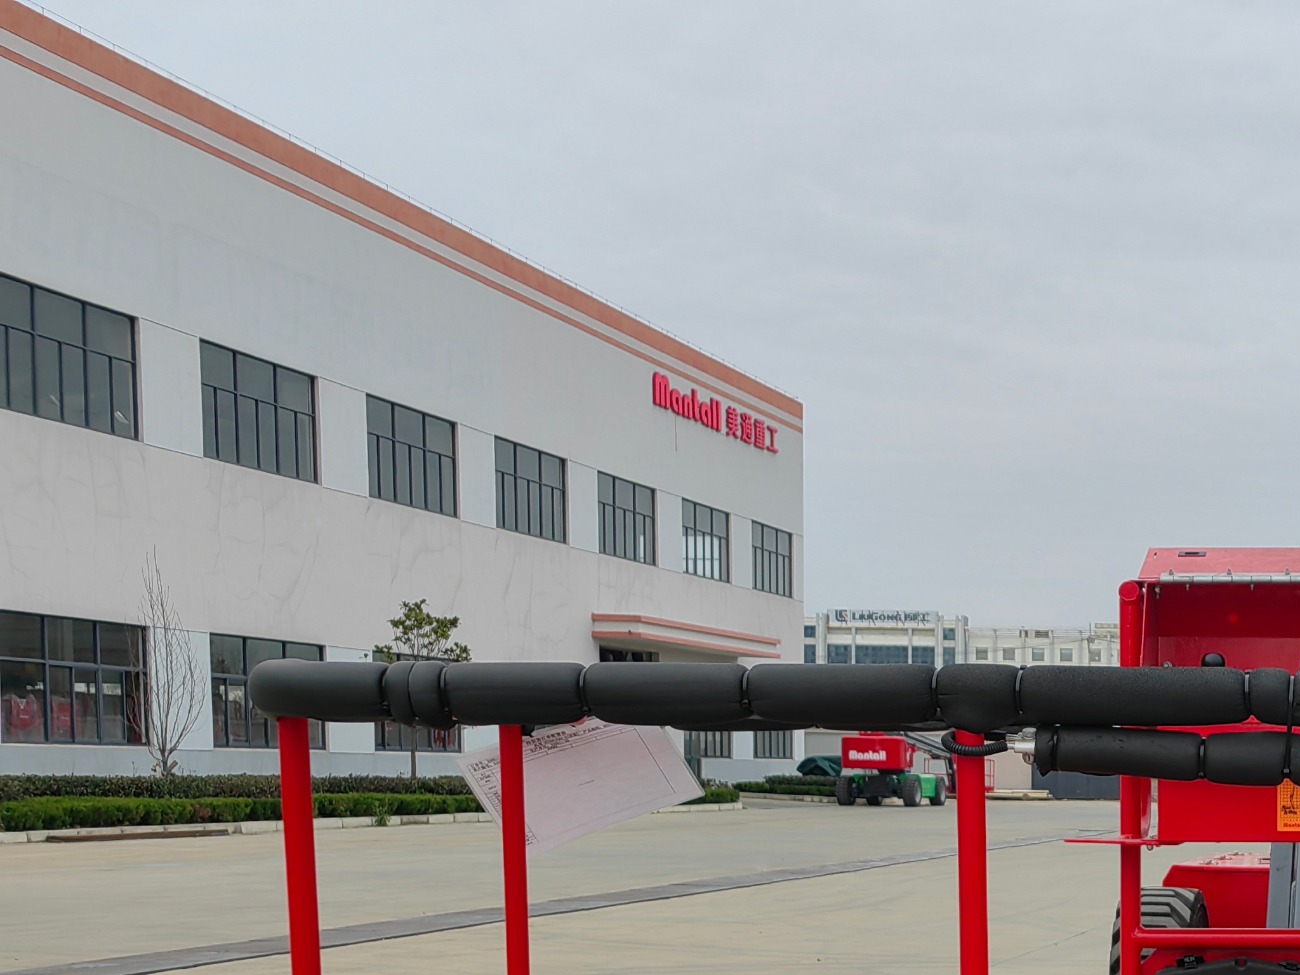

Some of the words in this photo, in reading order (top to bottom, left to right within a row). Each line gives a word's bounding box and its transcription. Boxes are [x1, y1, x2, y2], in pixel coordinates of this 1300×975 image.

[652, 371, 723, 432] Mantall
[726, 405, 779, 453] 美通重工
[848, 749, 887, 761] Mantall
